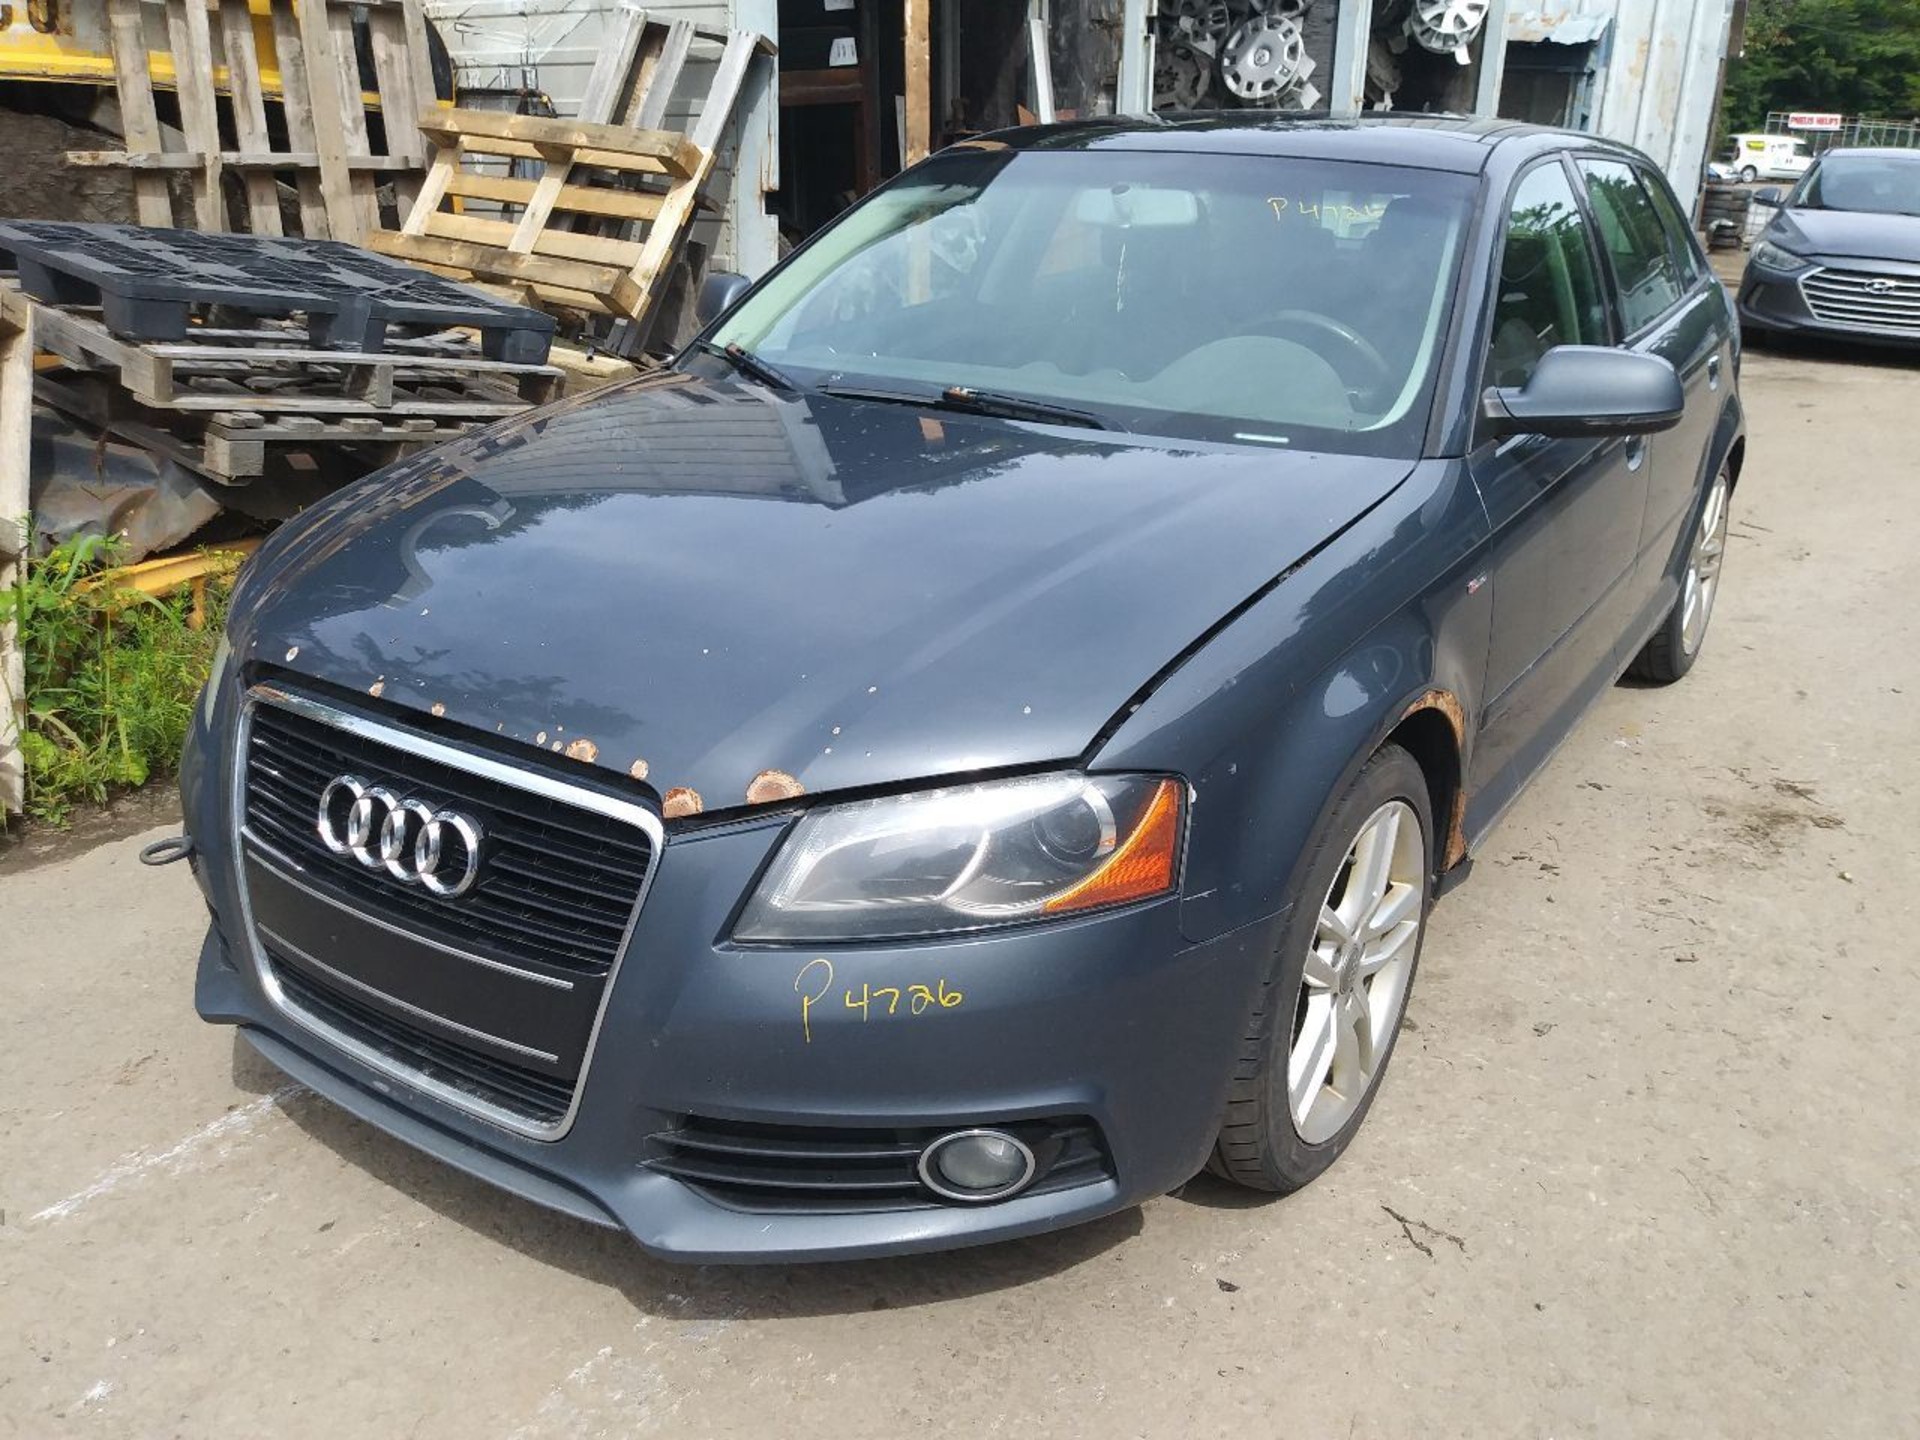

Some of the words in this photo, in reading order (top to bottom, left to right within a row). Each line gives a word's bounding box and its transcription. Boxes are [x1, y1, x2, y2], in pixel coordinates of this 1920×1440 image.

[1267, 197, 1289, 221] P
[794, 958, 834, 1044] P
[845, 979, 963, 1023] 4726
